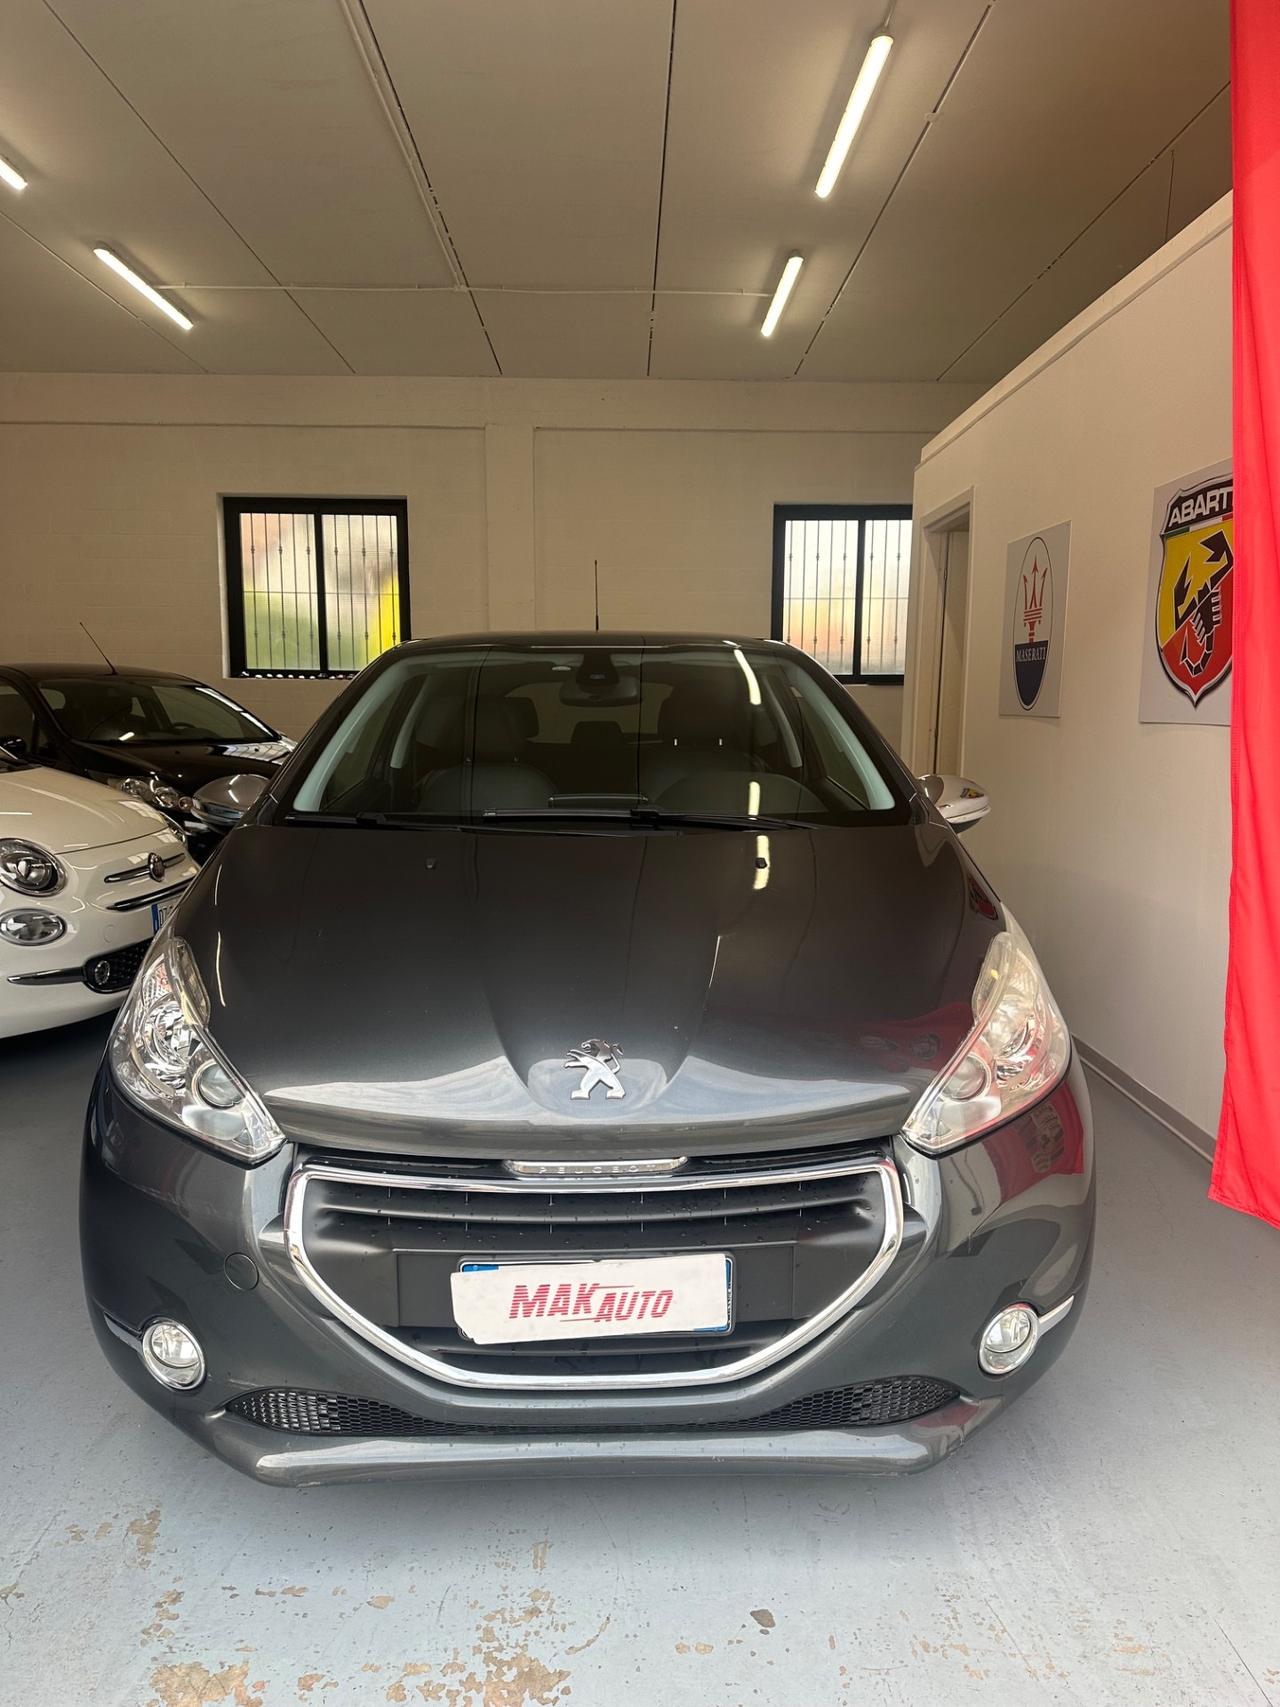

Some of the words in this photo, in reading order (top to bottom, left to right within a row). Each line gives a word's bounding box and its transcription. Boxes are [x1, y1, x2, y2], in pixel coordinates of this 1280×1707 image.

[1168, 486, 1233, 527] ABART
[1015, 646, 1047, 662] MASERATI
[508, 1283, 600, 1319] MAK
[594, 1289, 674, 1323] AUTO
